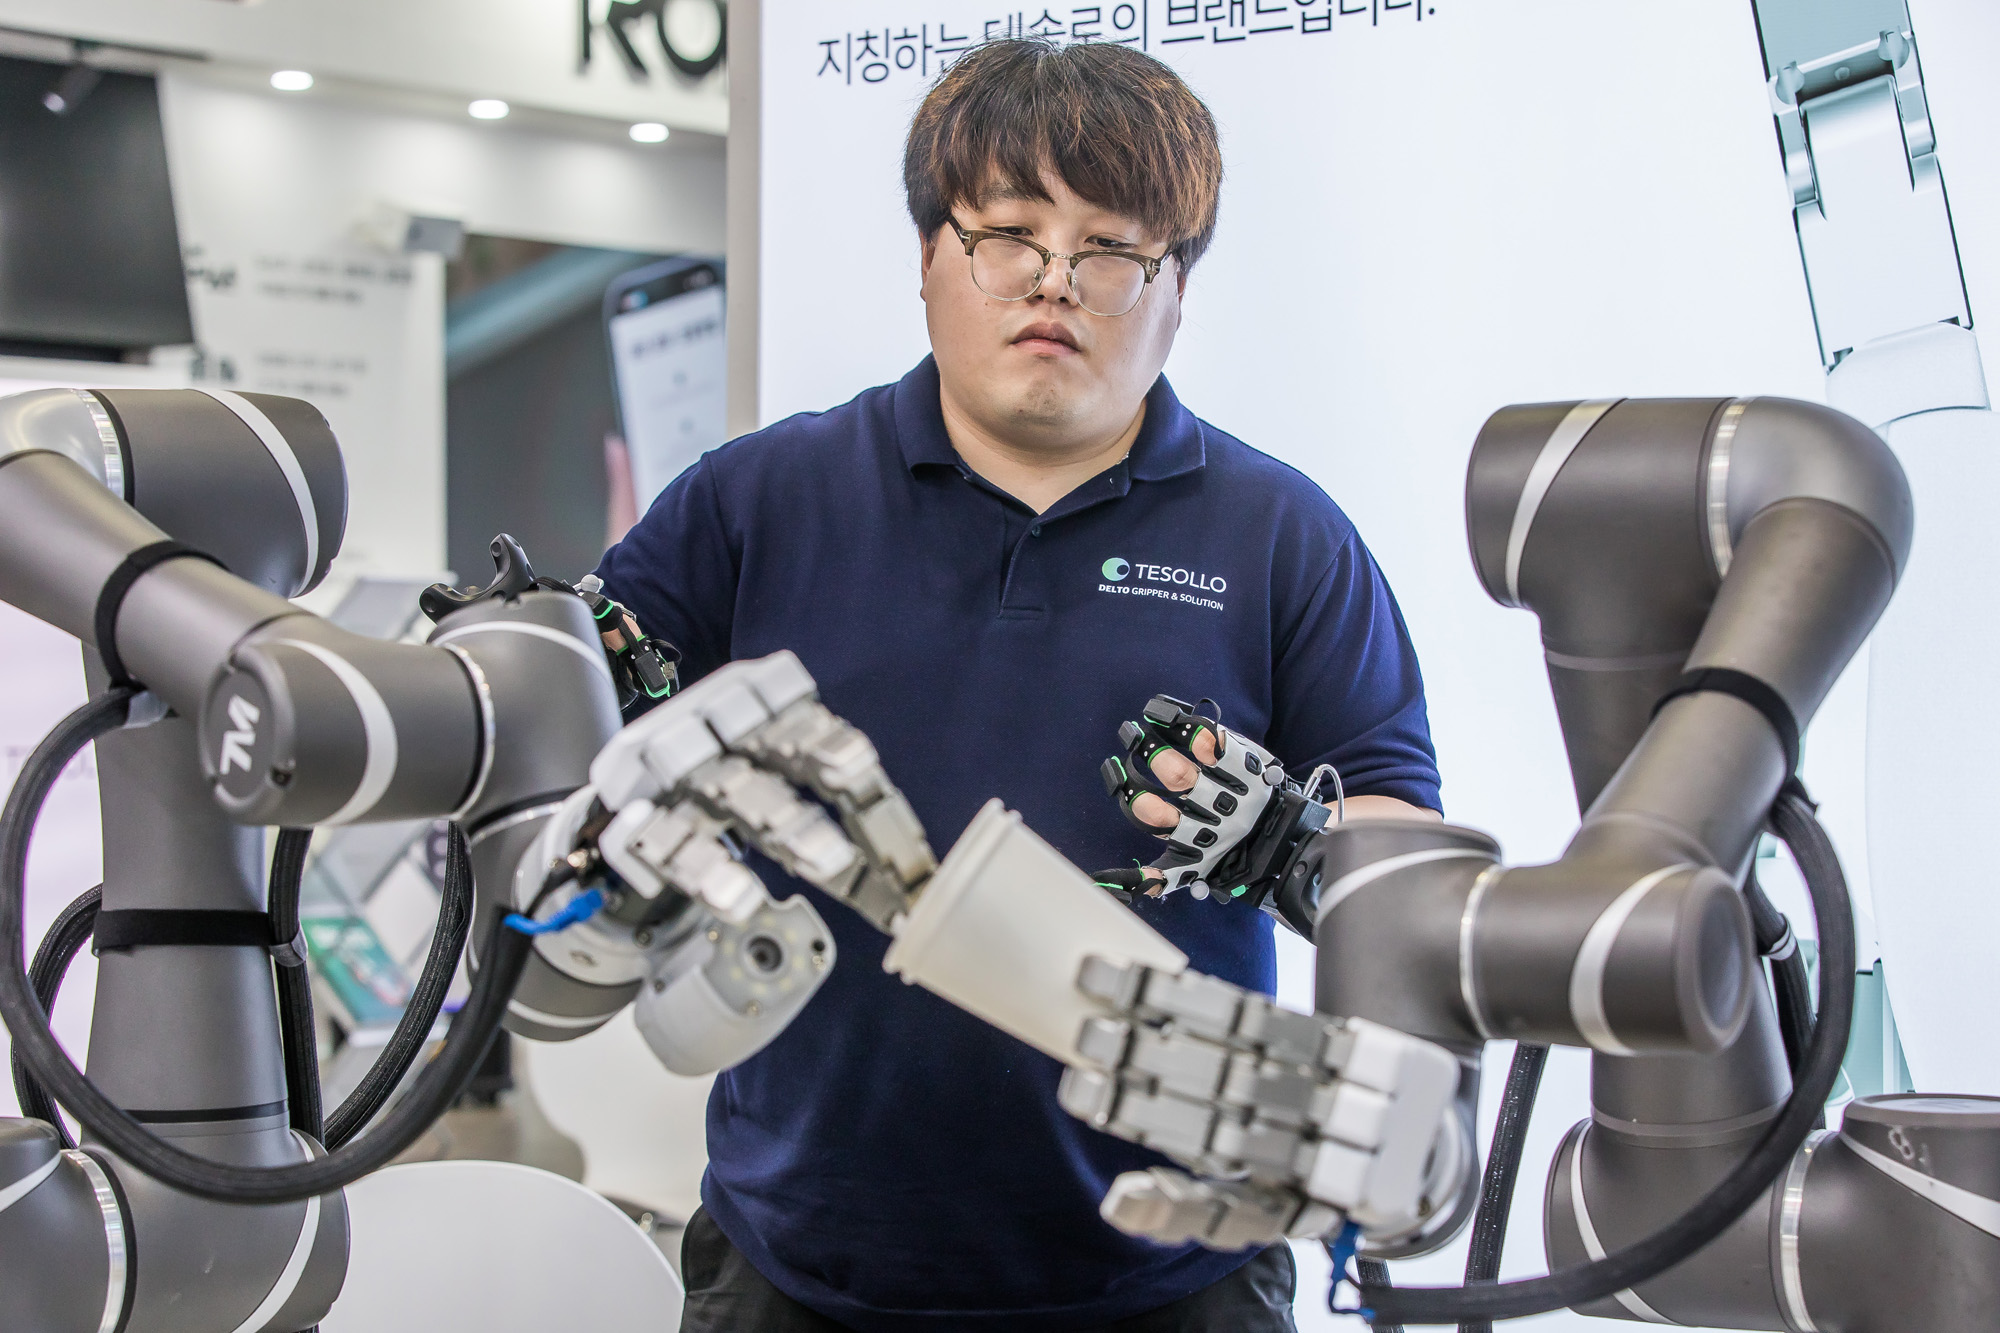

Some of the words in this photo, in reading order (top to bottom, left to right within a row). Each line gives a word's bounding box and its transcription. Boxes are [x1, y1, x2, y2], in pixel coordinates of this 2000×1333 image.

[817, 23, 970, 86] 지칭하는
[1135, 563, 1227, 593] TESOLLO
[1098, 584, 1130, 594] DELTO
[1131, 587, 1169, 600] GRIPPER
[1170, 592, 1178, 601] &
[1179, 593, 1223, 611] SOLUTION
